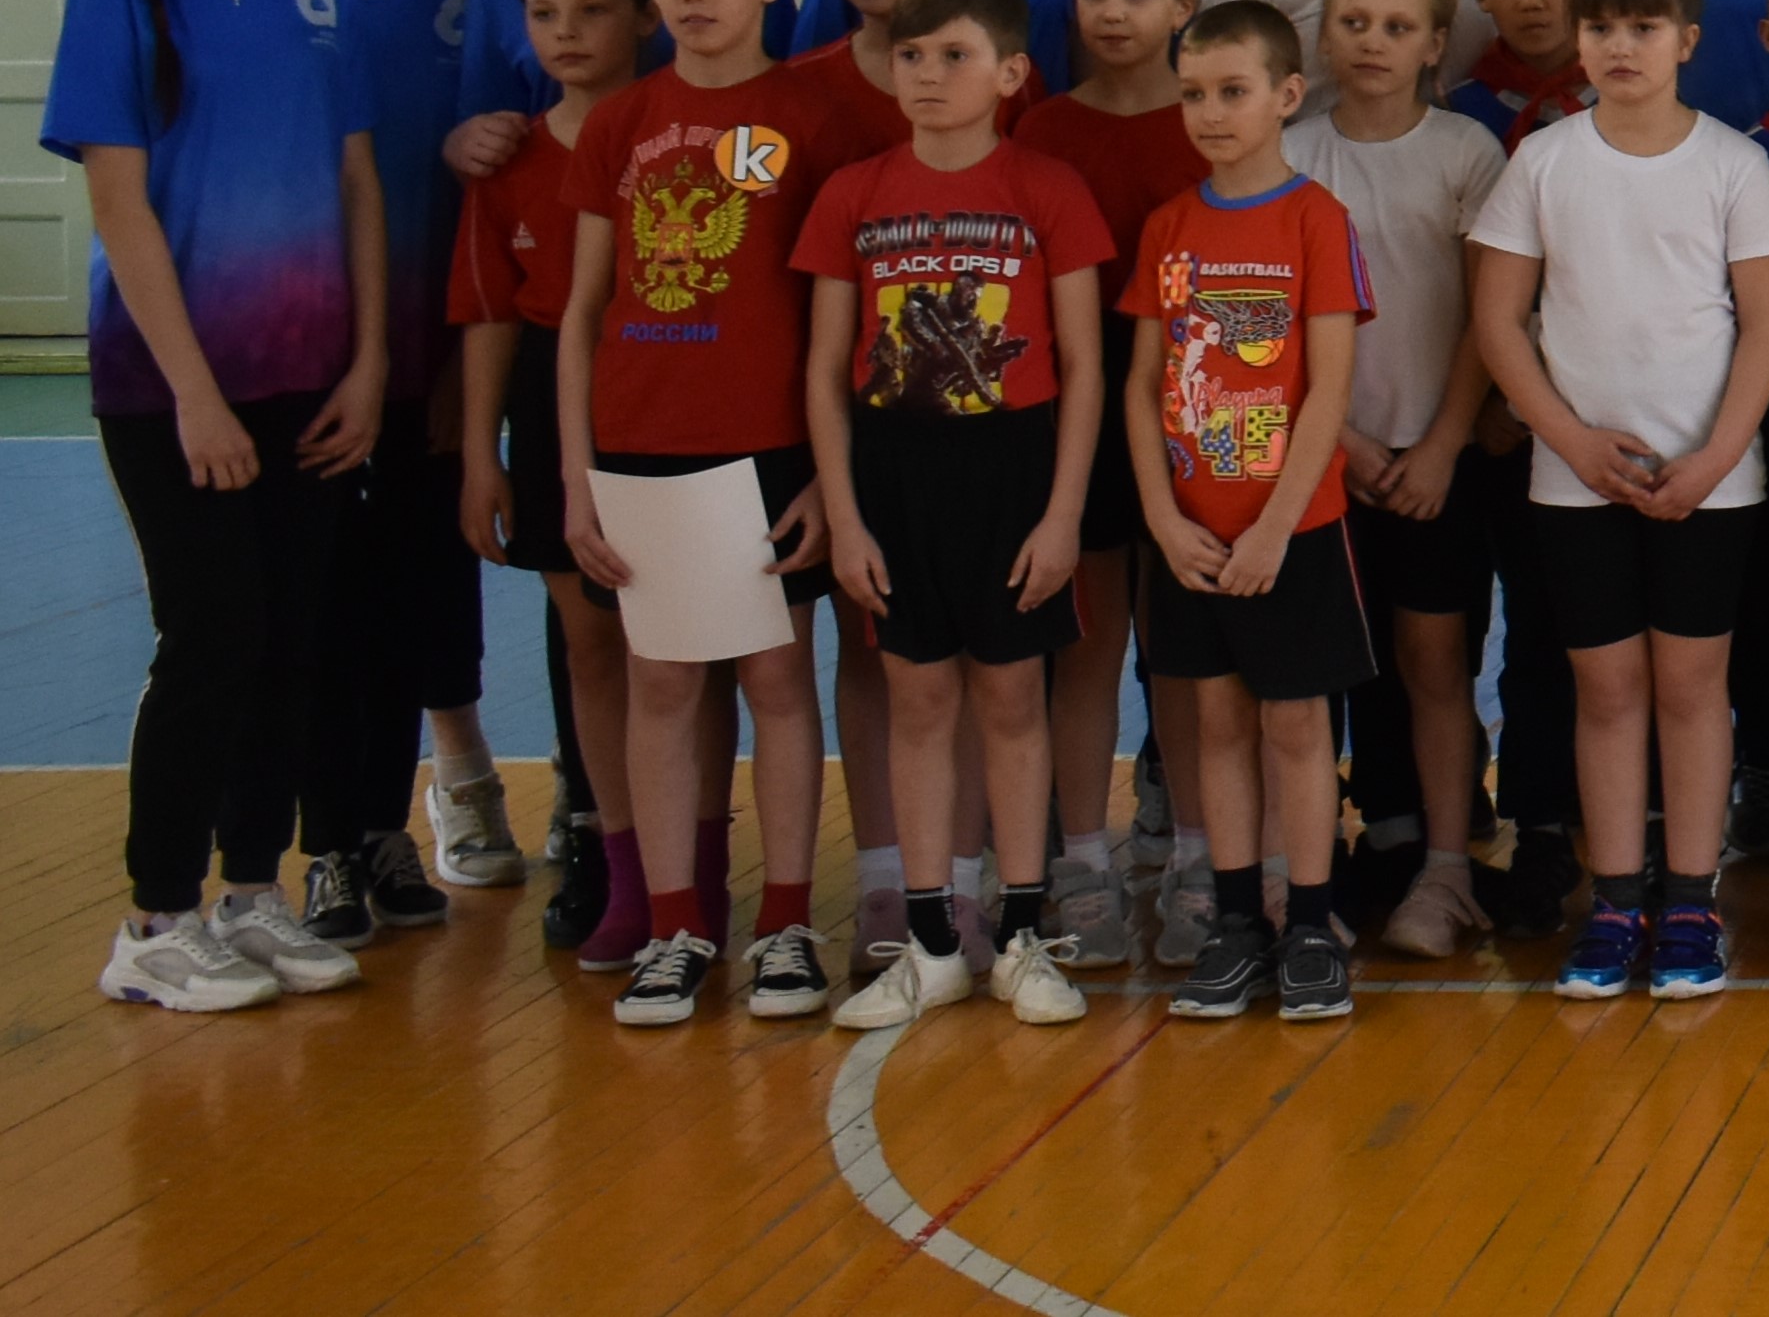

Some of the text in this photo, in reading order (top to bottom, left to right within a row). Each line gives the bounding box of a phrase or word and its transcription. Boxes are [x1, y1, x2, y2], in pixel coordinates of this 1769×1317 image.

[873, 255, 1000, 278] BLACK OPS
[621, 322, 719, 342] РОССИИ
[1198, 405, 1288, 479] 45
